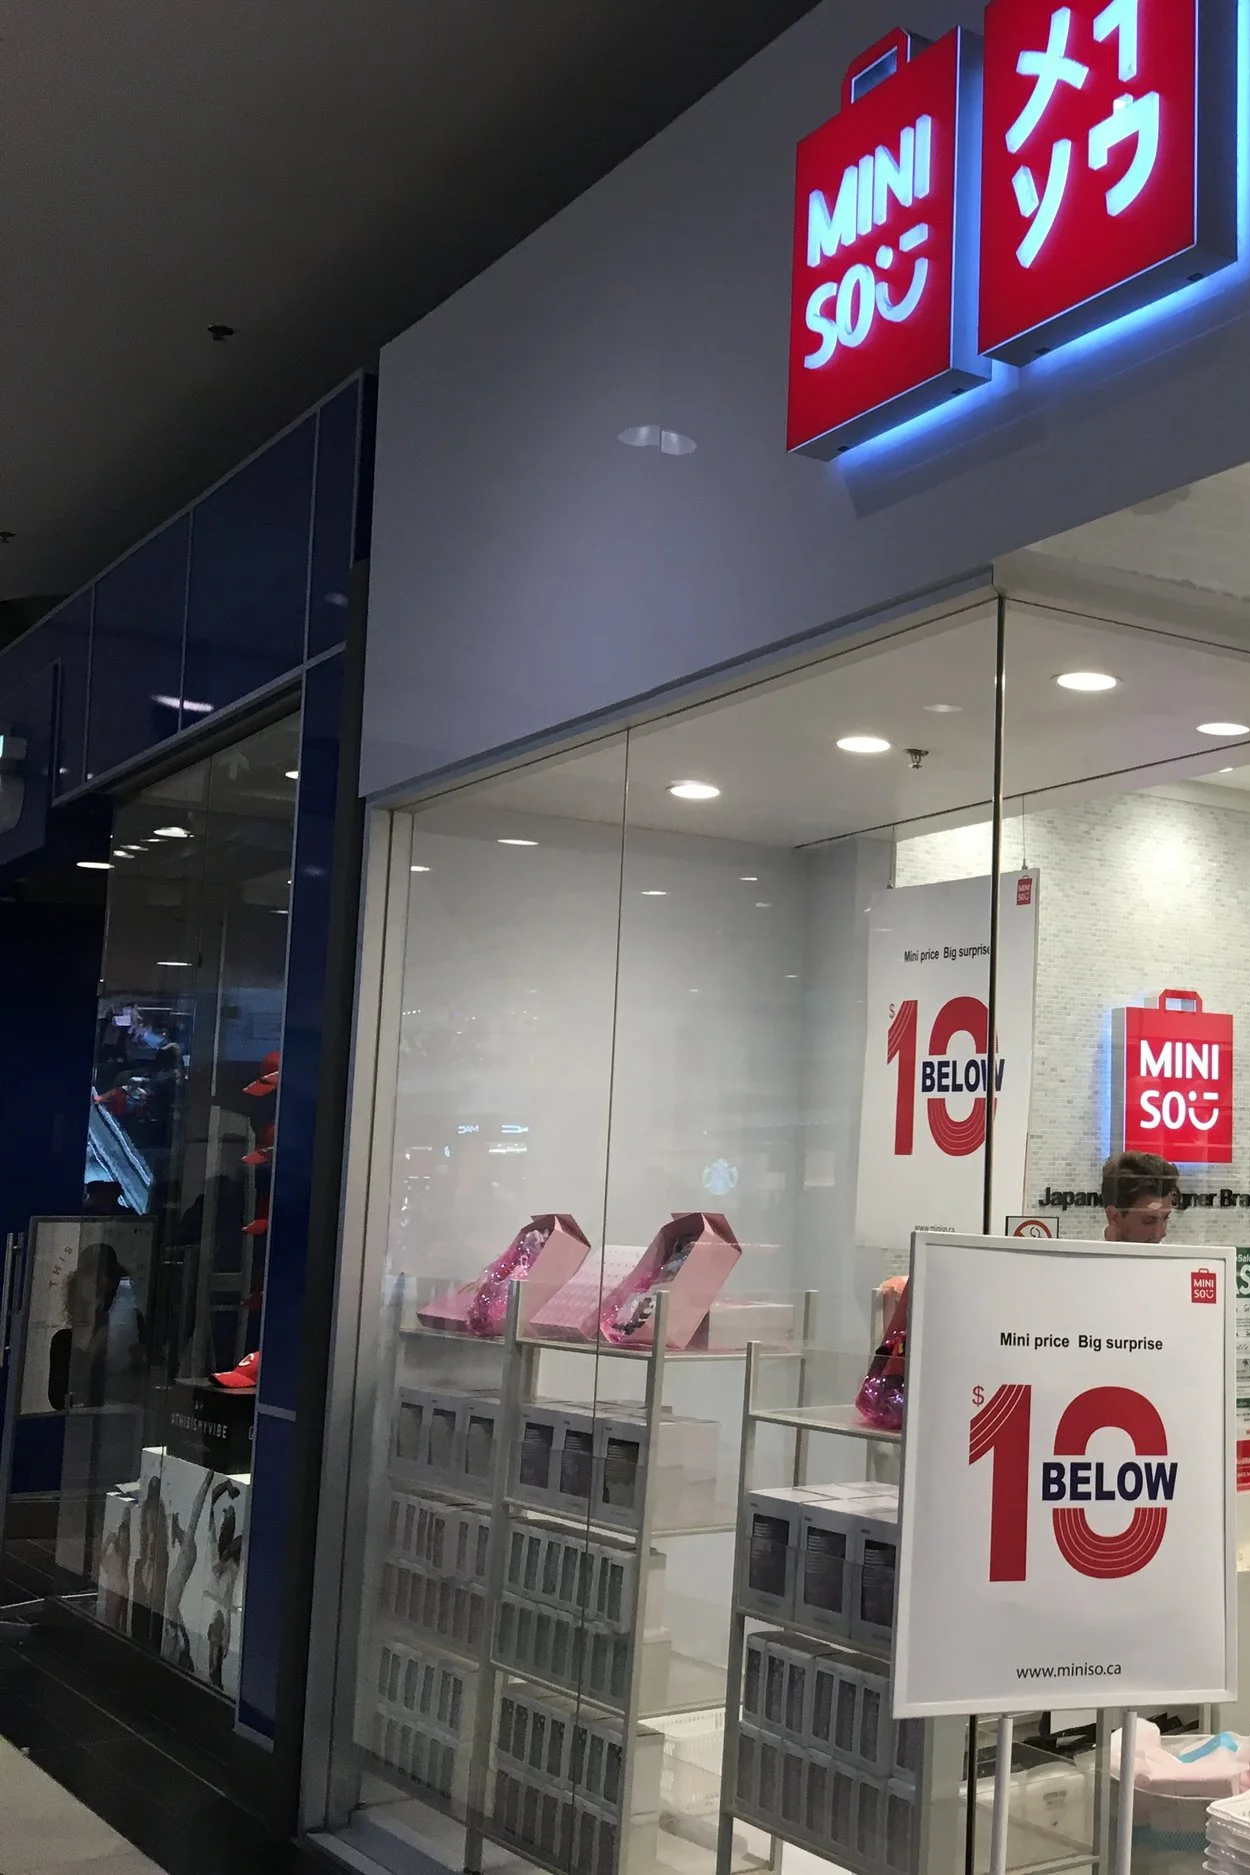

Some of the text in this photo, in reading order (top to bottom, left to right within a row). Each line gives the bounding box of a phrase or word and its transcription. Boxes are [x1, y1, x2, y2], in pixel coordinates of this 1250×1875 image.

[807, 114, 932, 268] MINI
[904, 950, 919, 962] Mini
[920, 948, 939, 963] price
[943, 946, 957, 960] Big
[887, 996, 998, 1157] 10
[1139, 1040, 1220, 1081] MINI
[1038, 1186, 1104, 1211] Japan
[1193, 1279, 1214, 1288] MINI
[999, 1332, 1163, 1352] Mini price Big surprise
[968, 1384, 1168, 1583] $ 10
[1041, 1461, 1178, 1501] BELOW
[1016, 1662, 1122, 1679] www.miniso.ca
